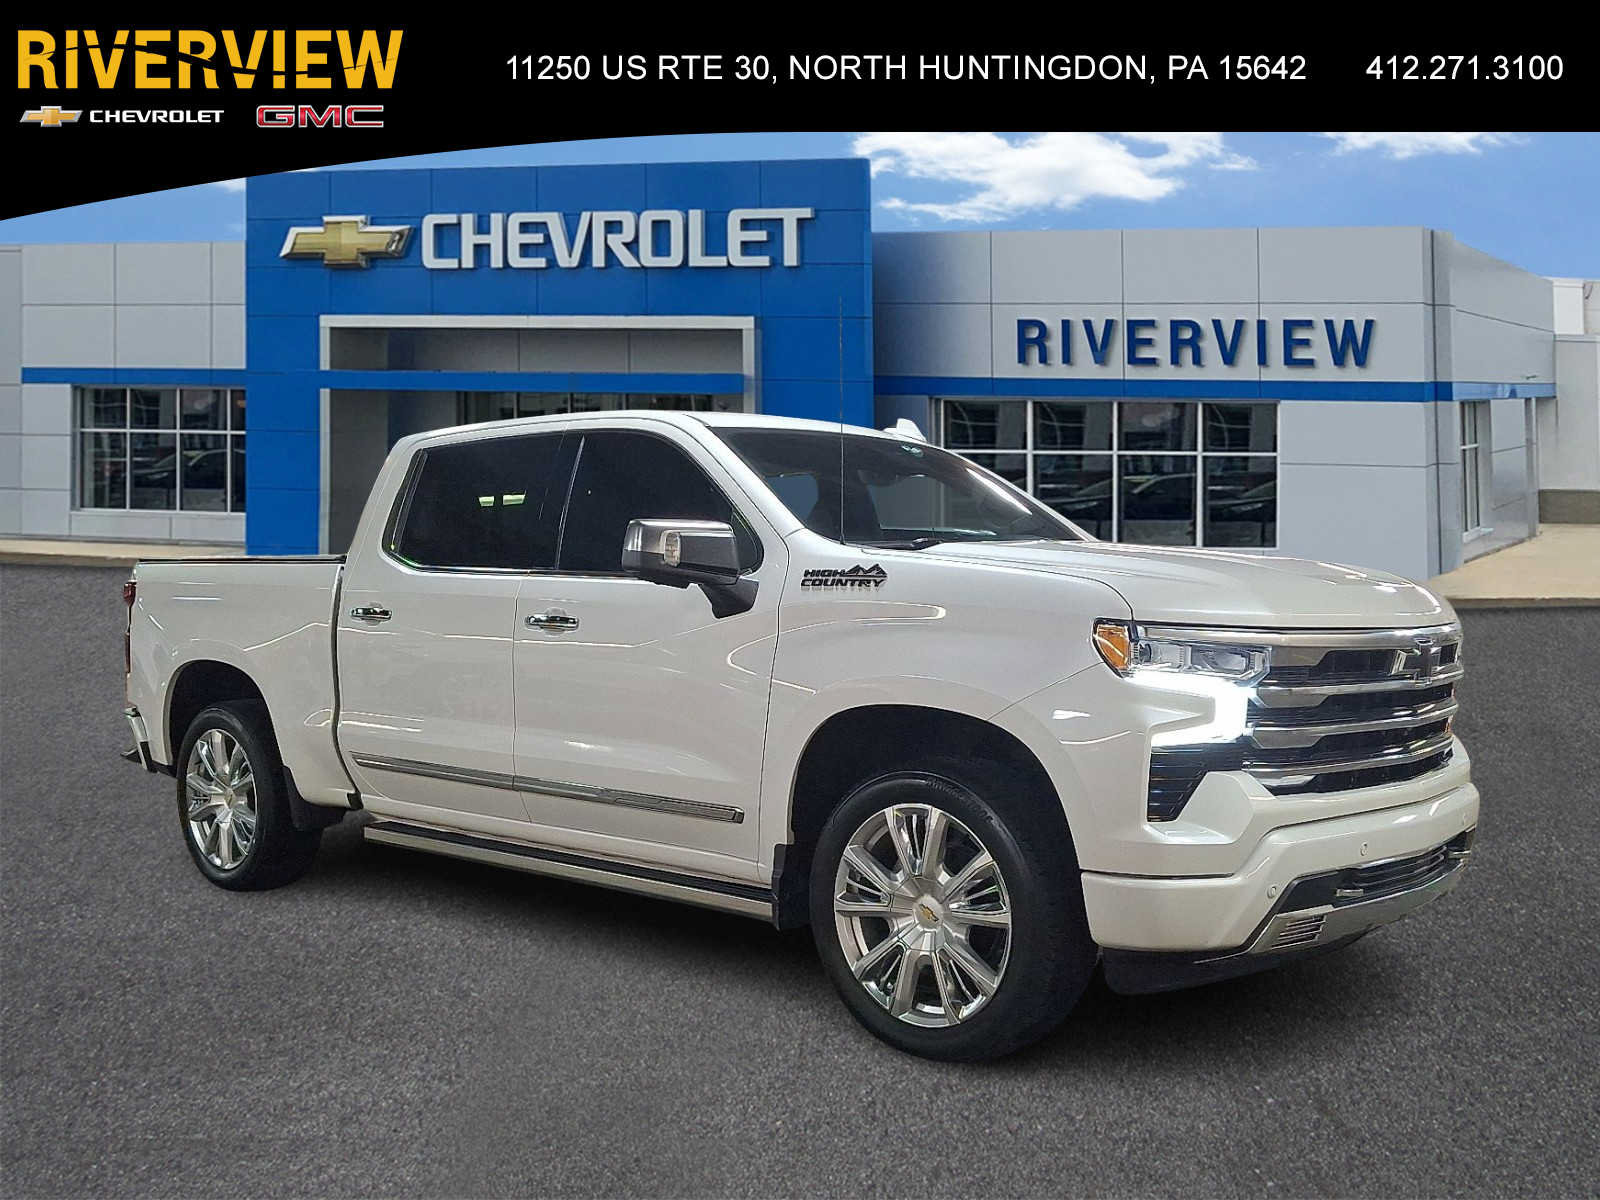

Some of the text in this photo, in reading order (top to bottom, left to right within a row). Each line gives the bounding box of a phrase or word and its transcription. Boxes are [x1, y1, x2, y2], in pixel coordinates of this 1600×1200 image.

[421, 207, 814, 270] CHEVROLET
[1016, 318, 1375, 367] RIVERVIEW
[801, 578, 886, 588] COUNTRY
[803, 569, 846, 578] HIGH
